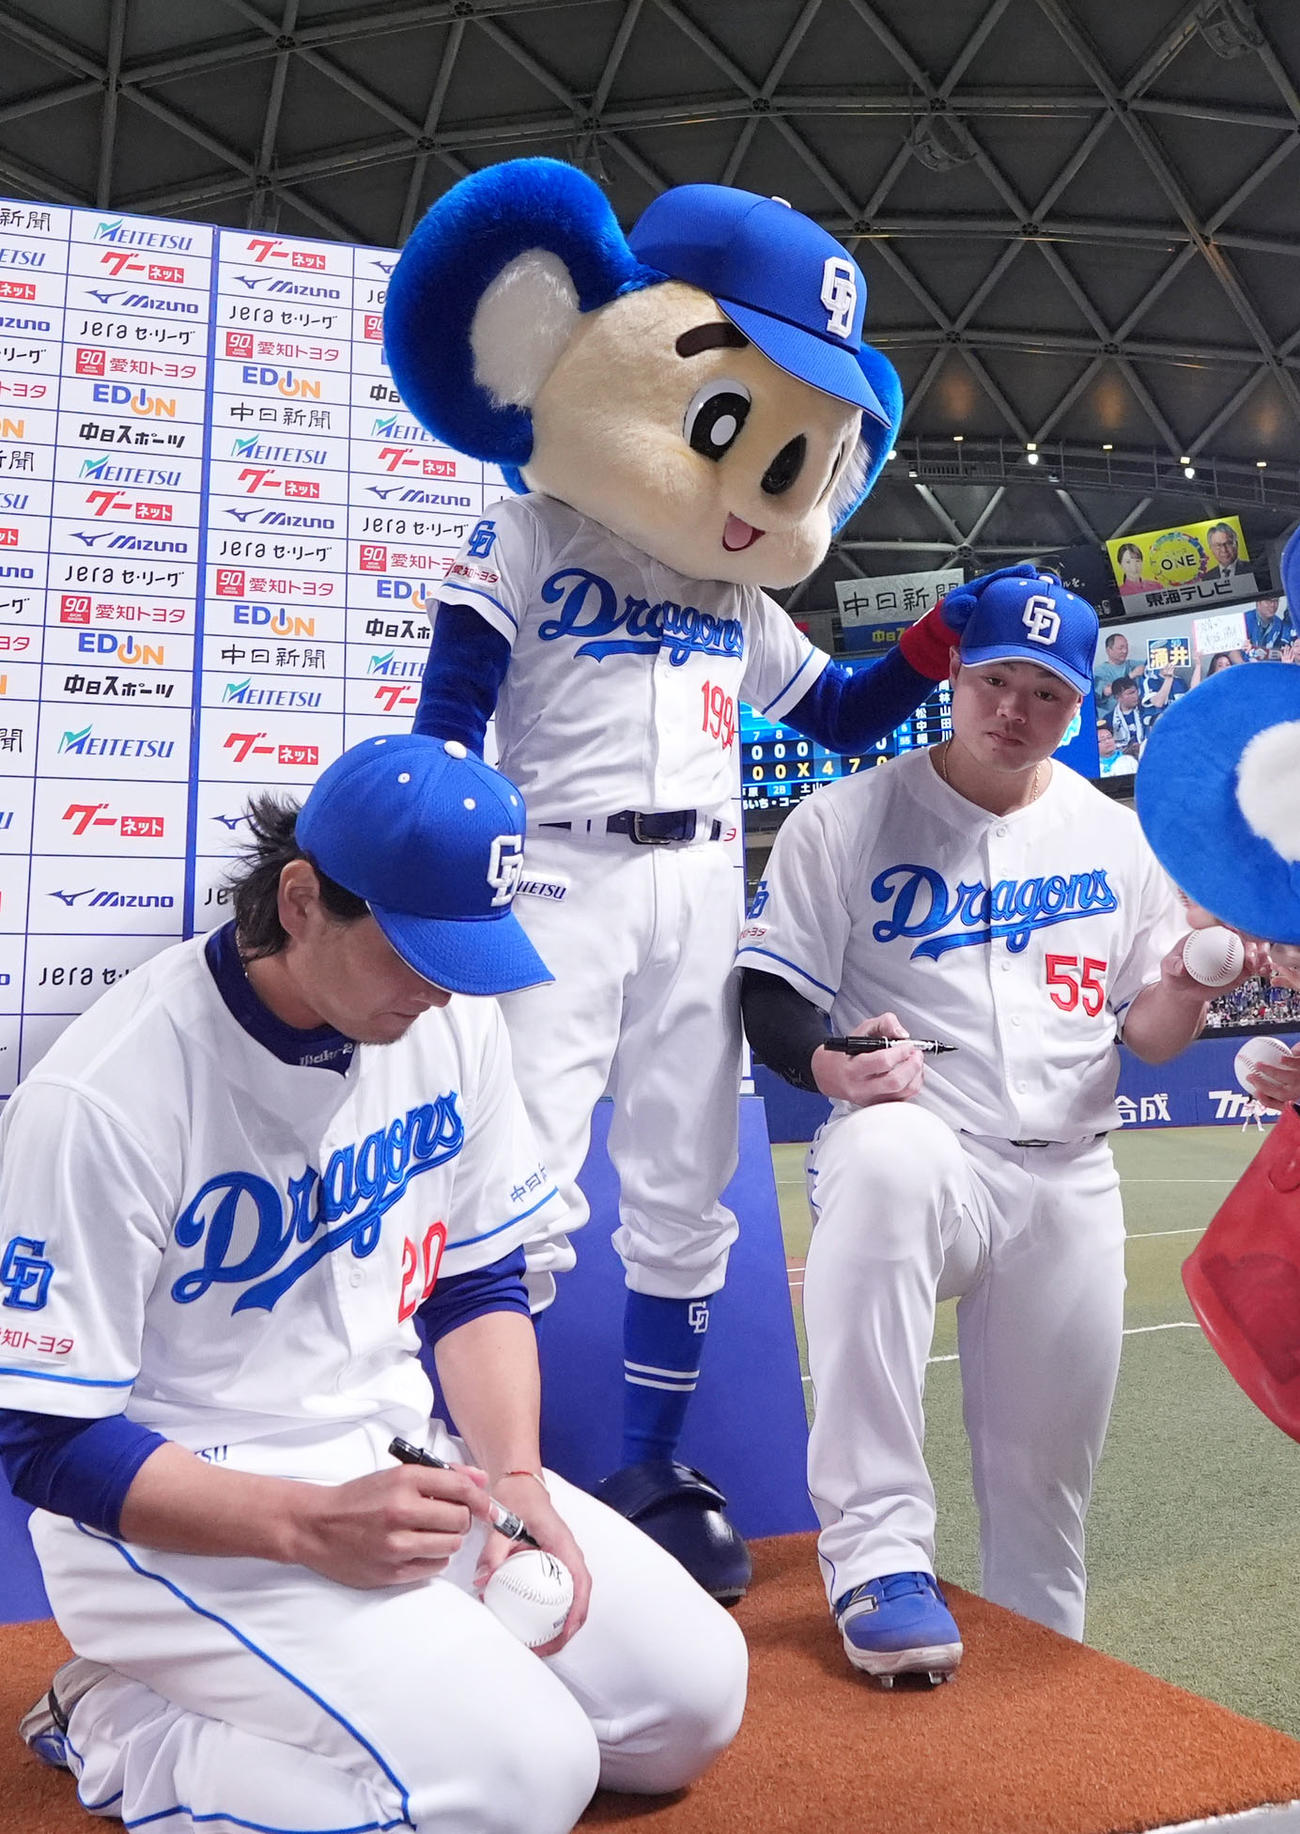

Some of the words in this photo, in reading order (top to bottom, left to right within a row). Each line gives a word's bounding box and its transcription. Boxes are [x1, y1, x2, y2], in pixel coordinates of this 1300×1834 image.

[94, 219, 193, 251] MEITETSU
[257, 341, 339, 362] 愛知トヨタ
[109, 358, 197, 379] 愛知トヨタ
[242, 365, 321, 399] EDION
[92, 384, 176, 417] EDION
[230, 402, 331, 430] 中日新聞
[79, 422, 186, 448] 中日スポーツ
[231, 433, 328, 465] MEITETSU
[78, 454, 182, 486] MEITETSU
[249, 577, 334, 597] 愛知トヨタ
[1146, 581, 1233, 607] 東海テレビ
[95, 604, 186, 623] 愛知トヨタ
[233, 604, 315, 637] EDION
[538, 568, 744, 667] Dragons
[78, 632, 165, 665] EDION
[220, 644, 326, 670] 中日新聞
[63, 674, 174, 698] 中日スポーツ
[221, 677, 322, 708] MEITETSU
[57, 723, 175, 758] MEITETSU
[751, 745, 763, 760] 0
[774, 744, 786, 759] 0
[797, 741, 809, 757] 0
[752, 765, 764, 780] 0
[775, 764, 787, 779] 0
[822, 761, 834, 775] 4
[849, 758, 861, 773] 7
[870, 863, 1119, 953] Dragons
[1045, 953, 1107, 1018] 55
[171, 1089, 465, 1304] Dragons
[398, 1220, 449, 1324] 20
[0, 1328, 74, 1355] 知トヨタ
